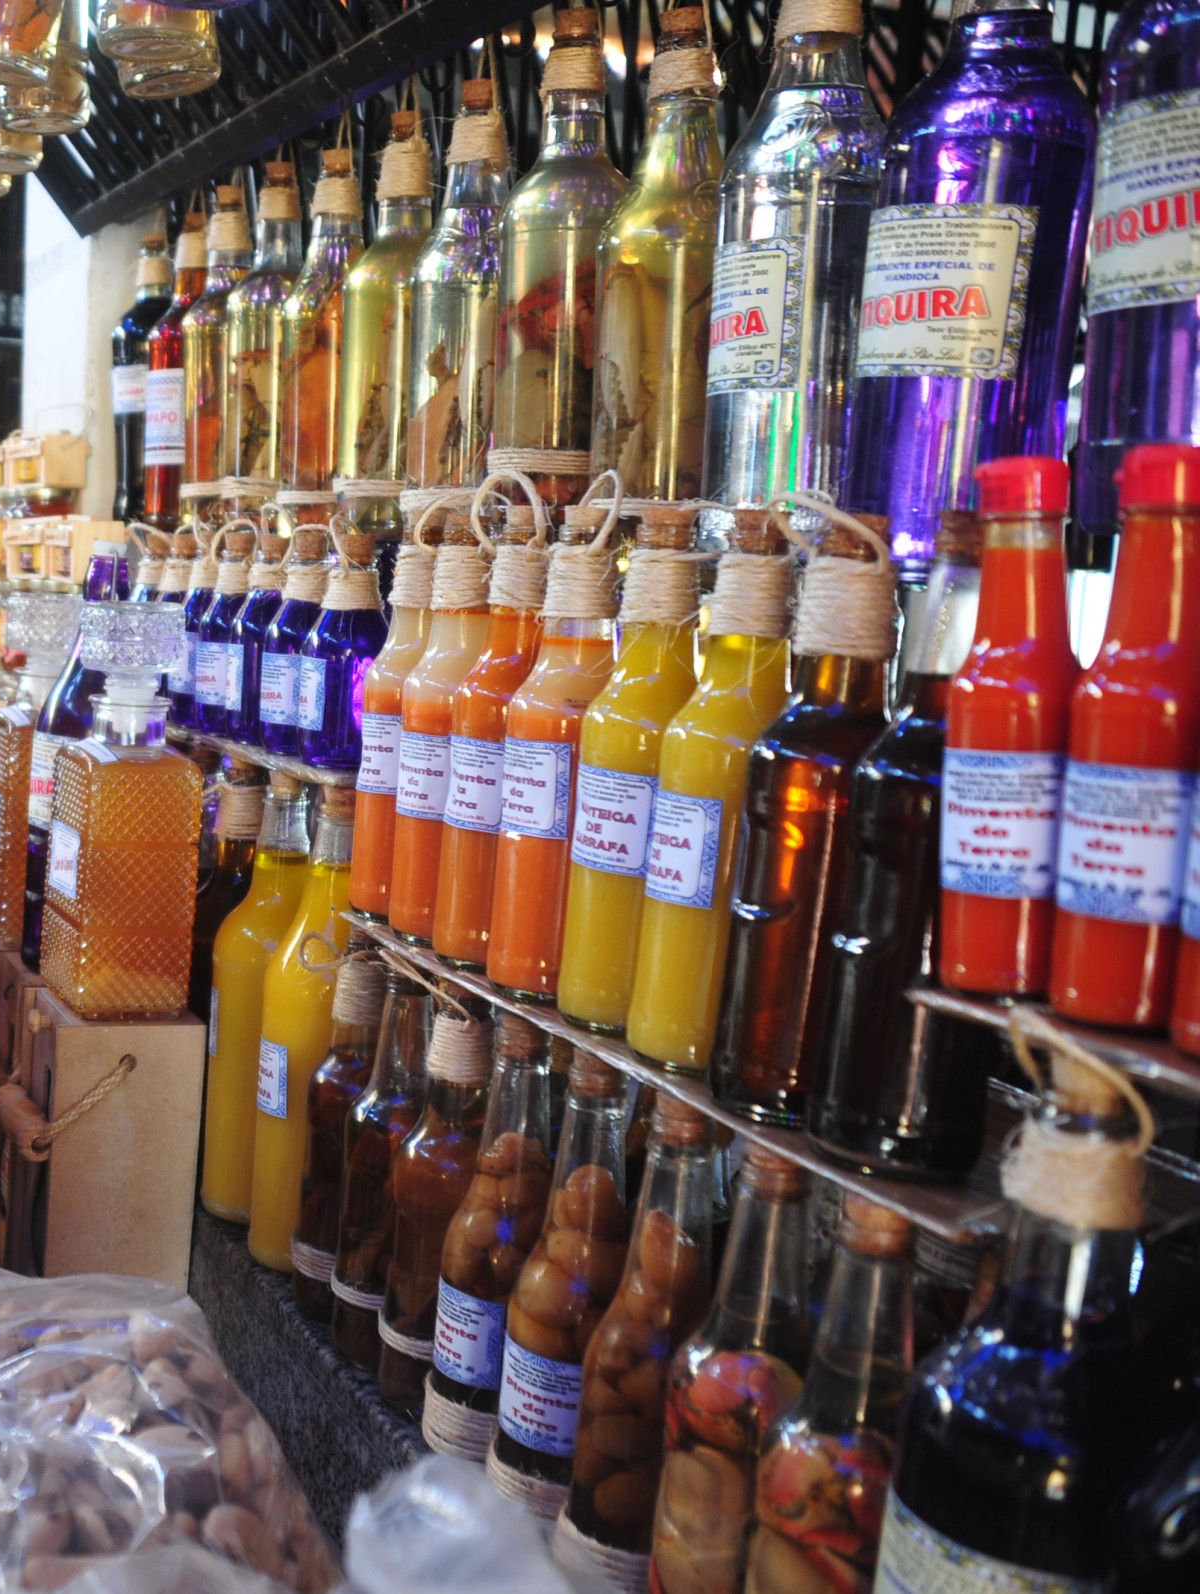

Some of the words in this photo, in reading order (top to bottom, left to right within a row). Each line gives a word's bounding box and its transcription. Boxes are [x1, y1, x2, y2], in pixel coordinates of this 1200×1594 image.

[945, 221, 1014, 231] Trabalhadores
[914, 260, 974, 271] ESPECIAL
[978, 262, 996, 271] DE
[884, 272, 940, 282] MANDIOCA
[756, 287, 769, 295] DE
[860, 284, 990, 332] TIQUIRA
[407, 776, 420, 787] da
[509, 786, 524, 798] da
[585, 820, 602, 834] DE
[973, 824, 1009, 838] da
[959, 840, 1031, 858] Terra
[1086, 837, 1123, 855] da
[439, 1330, 453, 1344] da
[506, 1374, 578, 1411] Pimenta
[522, 1402, 546, 1417] da
[512, 1406, 558, 1433] Terra
